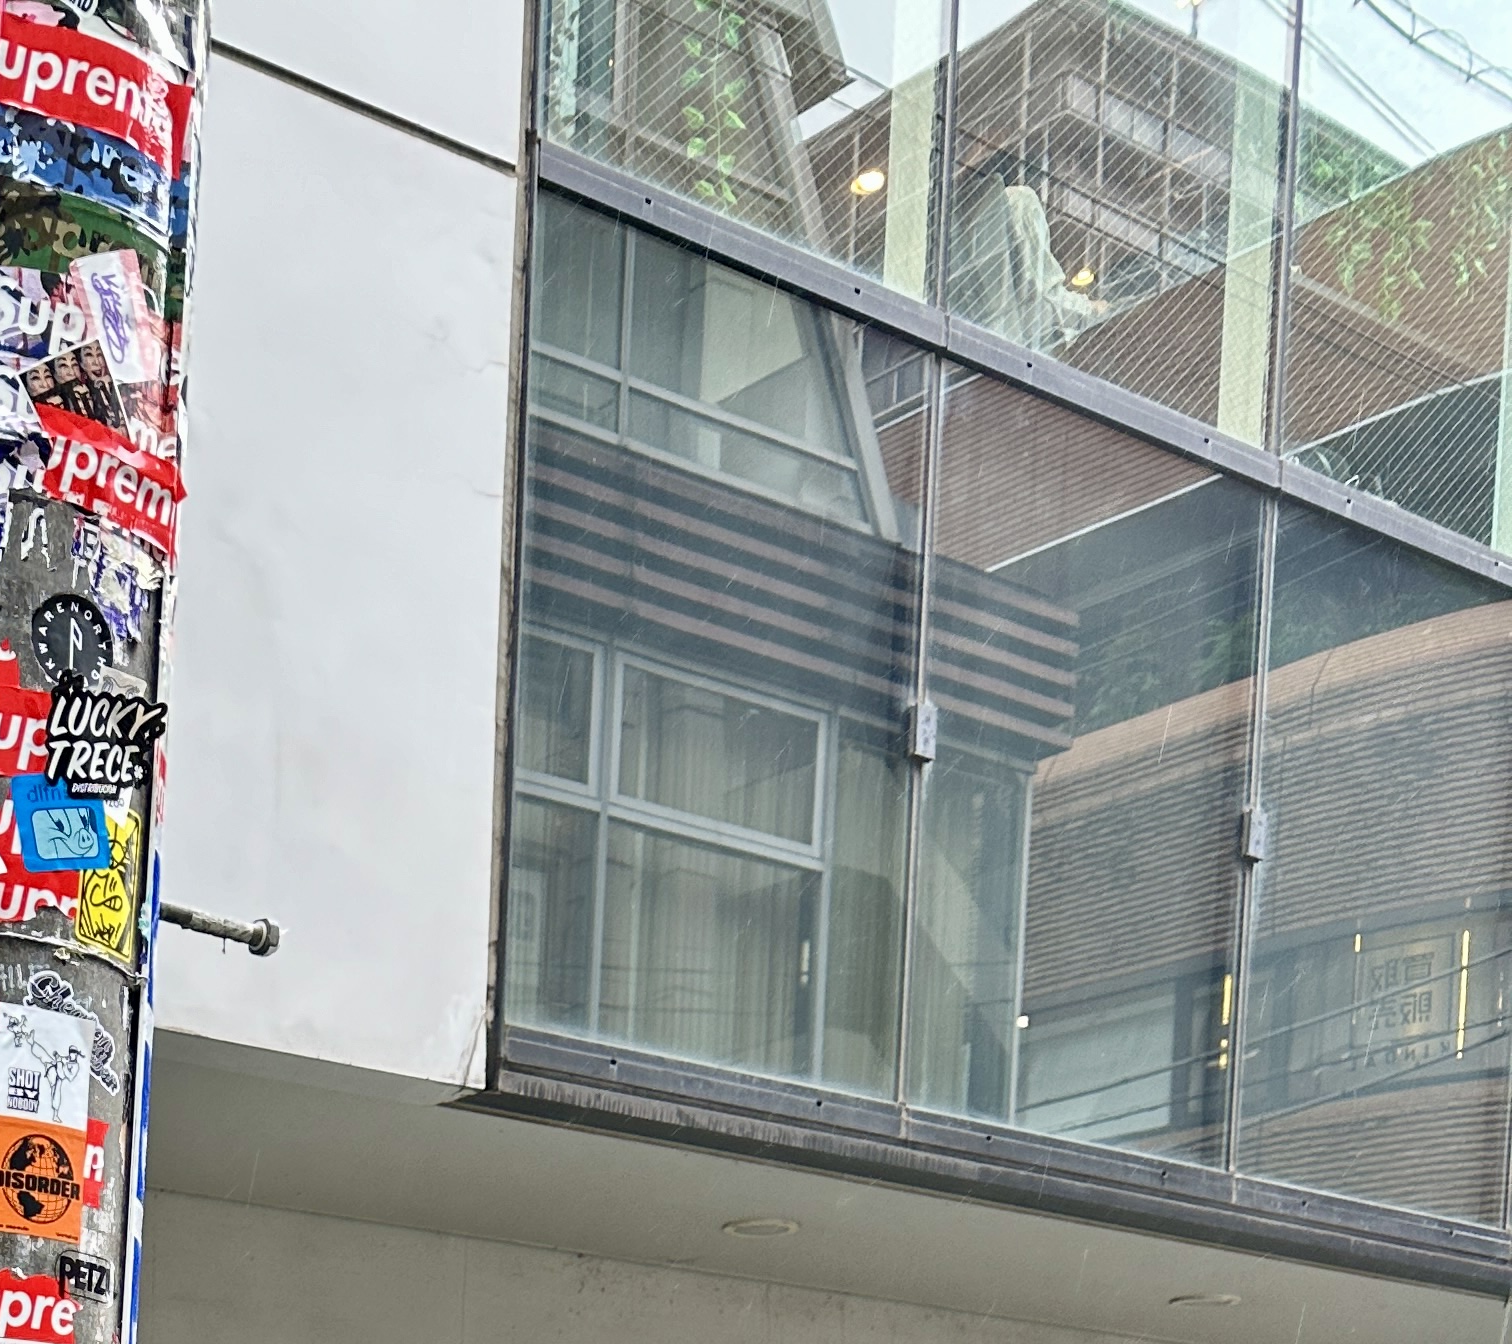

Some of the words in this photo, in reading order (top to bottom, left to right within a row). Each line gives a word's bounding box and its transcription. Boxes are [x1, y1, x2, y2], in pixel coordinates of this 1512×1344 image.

[50, 696, 162, 741] LUCKY
[46, 740, 140, 784] TRECE
[7, 1088, 39, 1098] BY
[8, 1067, 41, 1091] SHOT
